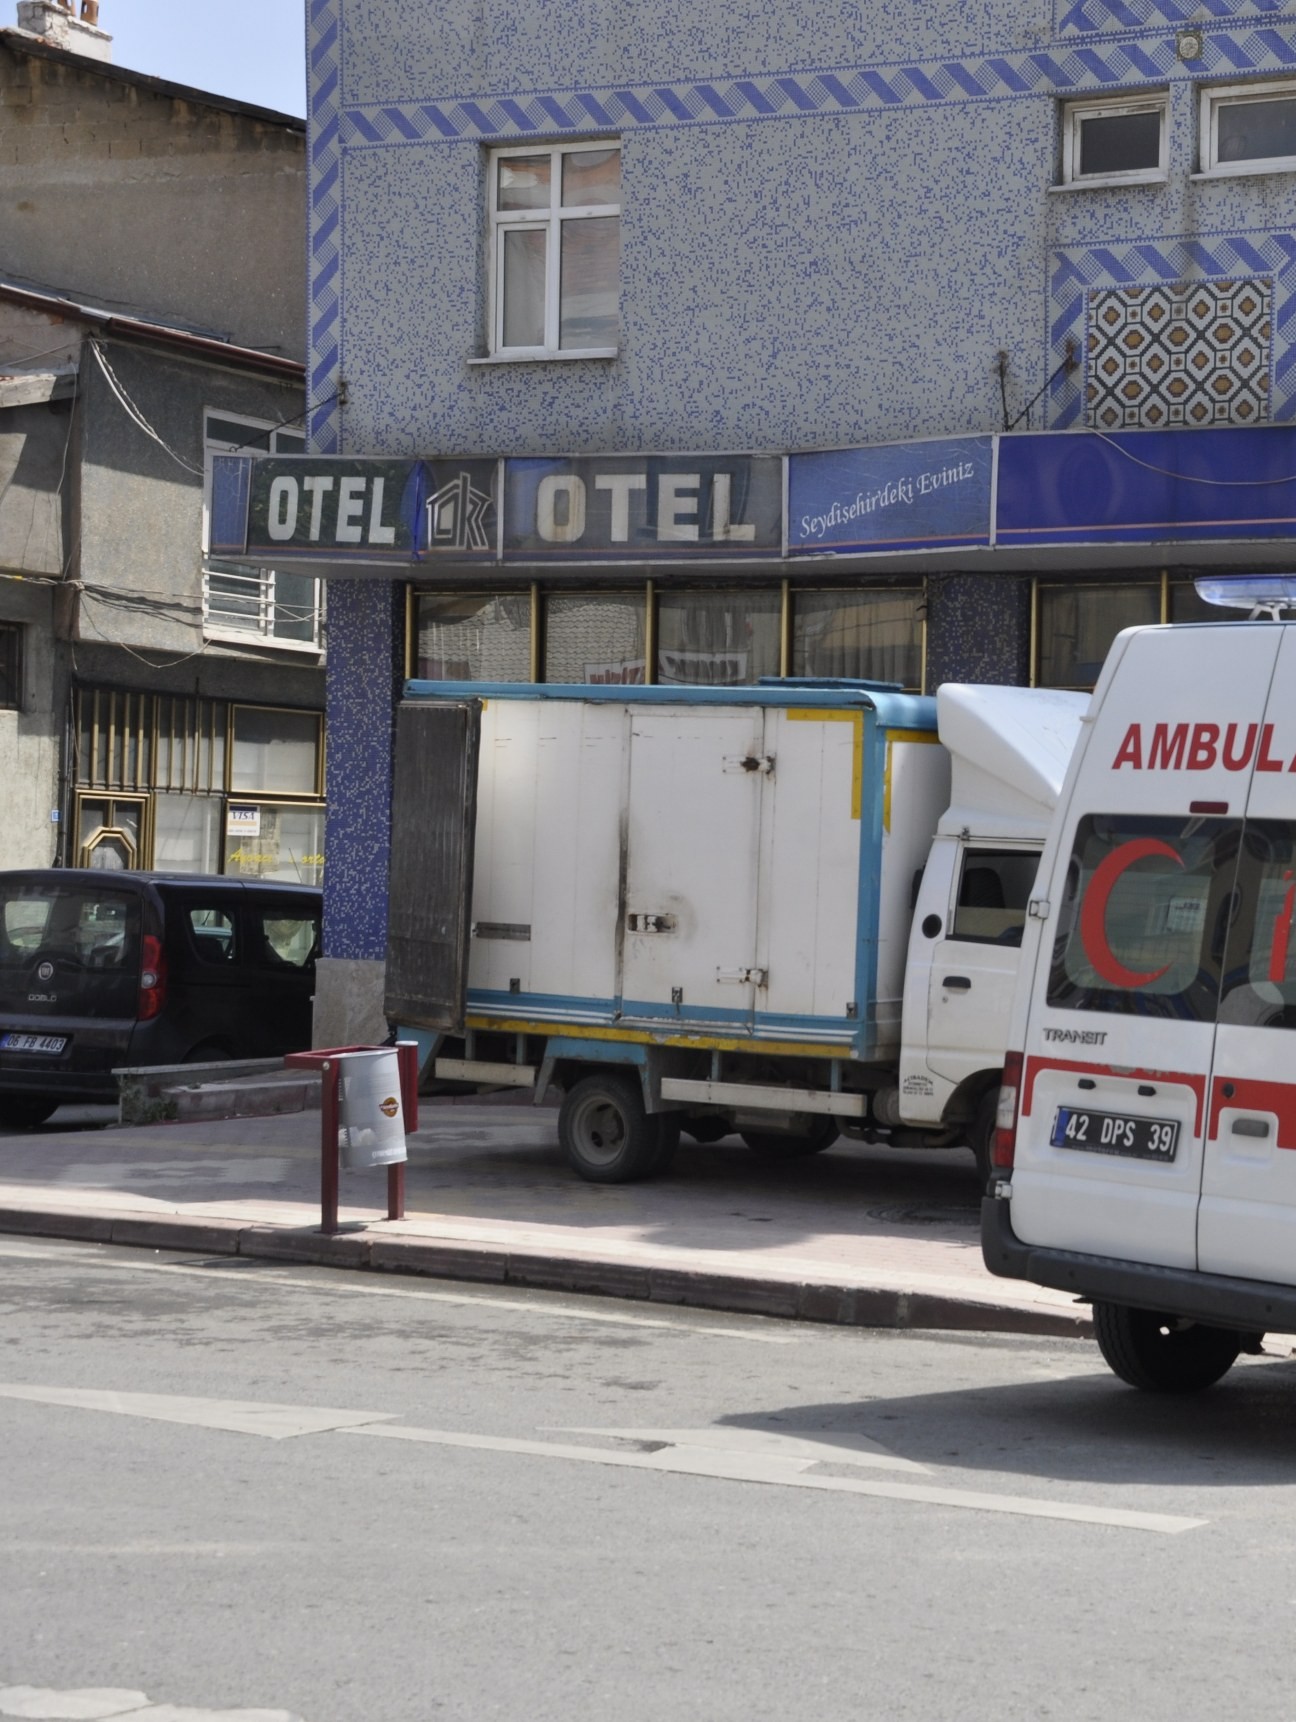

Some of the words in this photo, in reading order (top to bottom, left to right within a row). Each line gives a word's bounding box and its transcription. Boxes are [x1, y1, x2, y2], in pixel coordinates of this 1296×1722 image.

[916, 462, 975, 496] Eviniz
[267, 475, 396, 544] OTEL
[536, 473, 756, 542] OTEL
[7, 1034, 21, 1047] 06
[1042, 1027, 1108, 1046] TRANSIT
[1065, 1113, 1090, 1141] 42
[1100, 1117, 1137, 1147] DPS
[1147, 1124, 1172, 1152] 39
